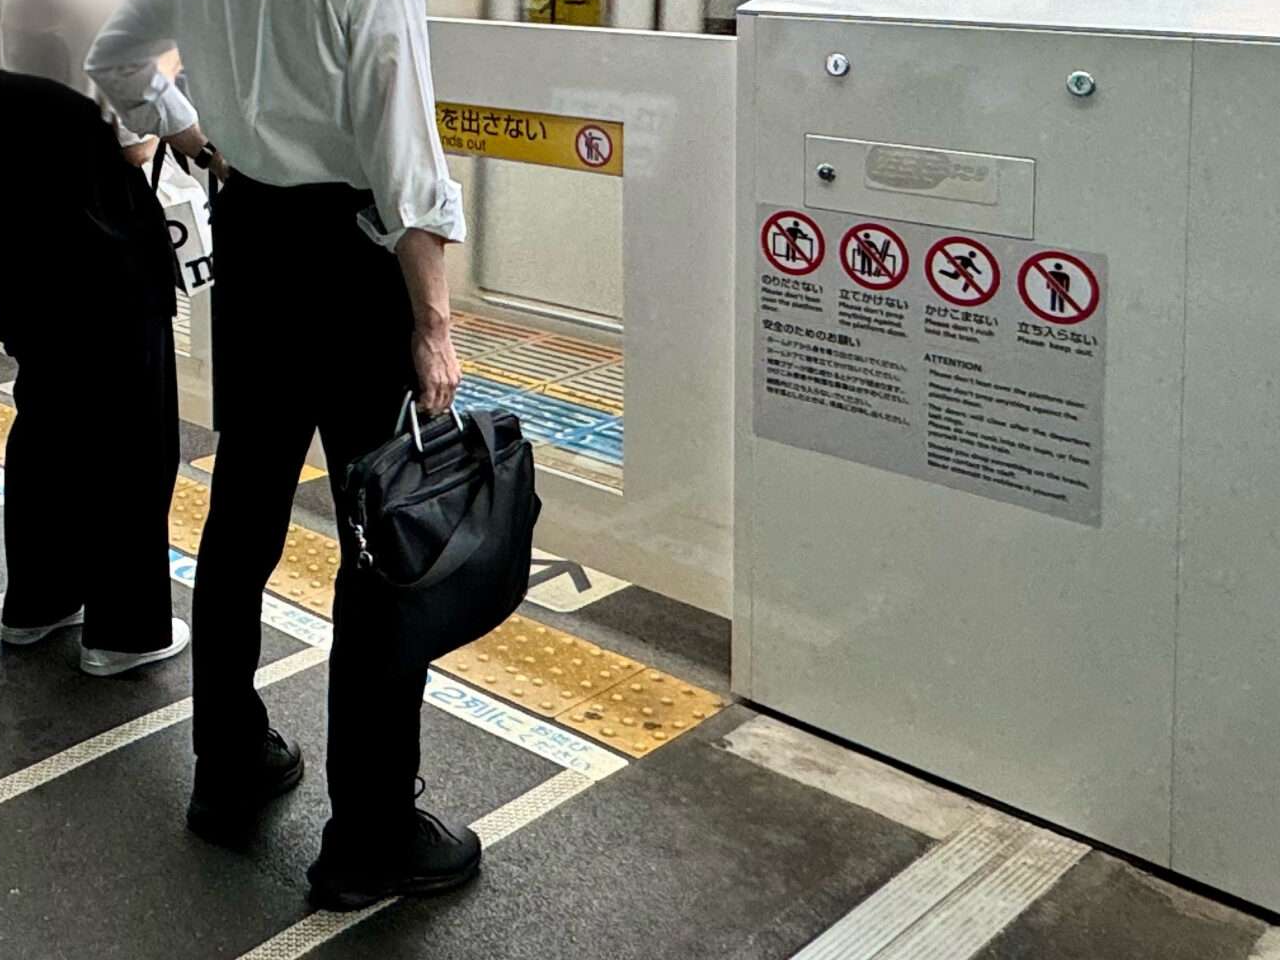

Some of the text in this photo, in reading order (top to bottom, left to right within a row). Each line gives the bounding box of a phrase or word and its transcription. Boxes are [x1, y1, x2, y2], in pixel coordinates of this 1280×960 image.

[436, 108, 547, 140] を出さない
[761, 274, 823, 295] のりださない
[838, 288, 908, 311] 立てかけない
[924, 303, 998, 328] かけこまない
[1016, 320, 1097, 347] 立ち入らない
[924, 352, 982, 372] ATTENTION
